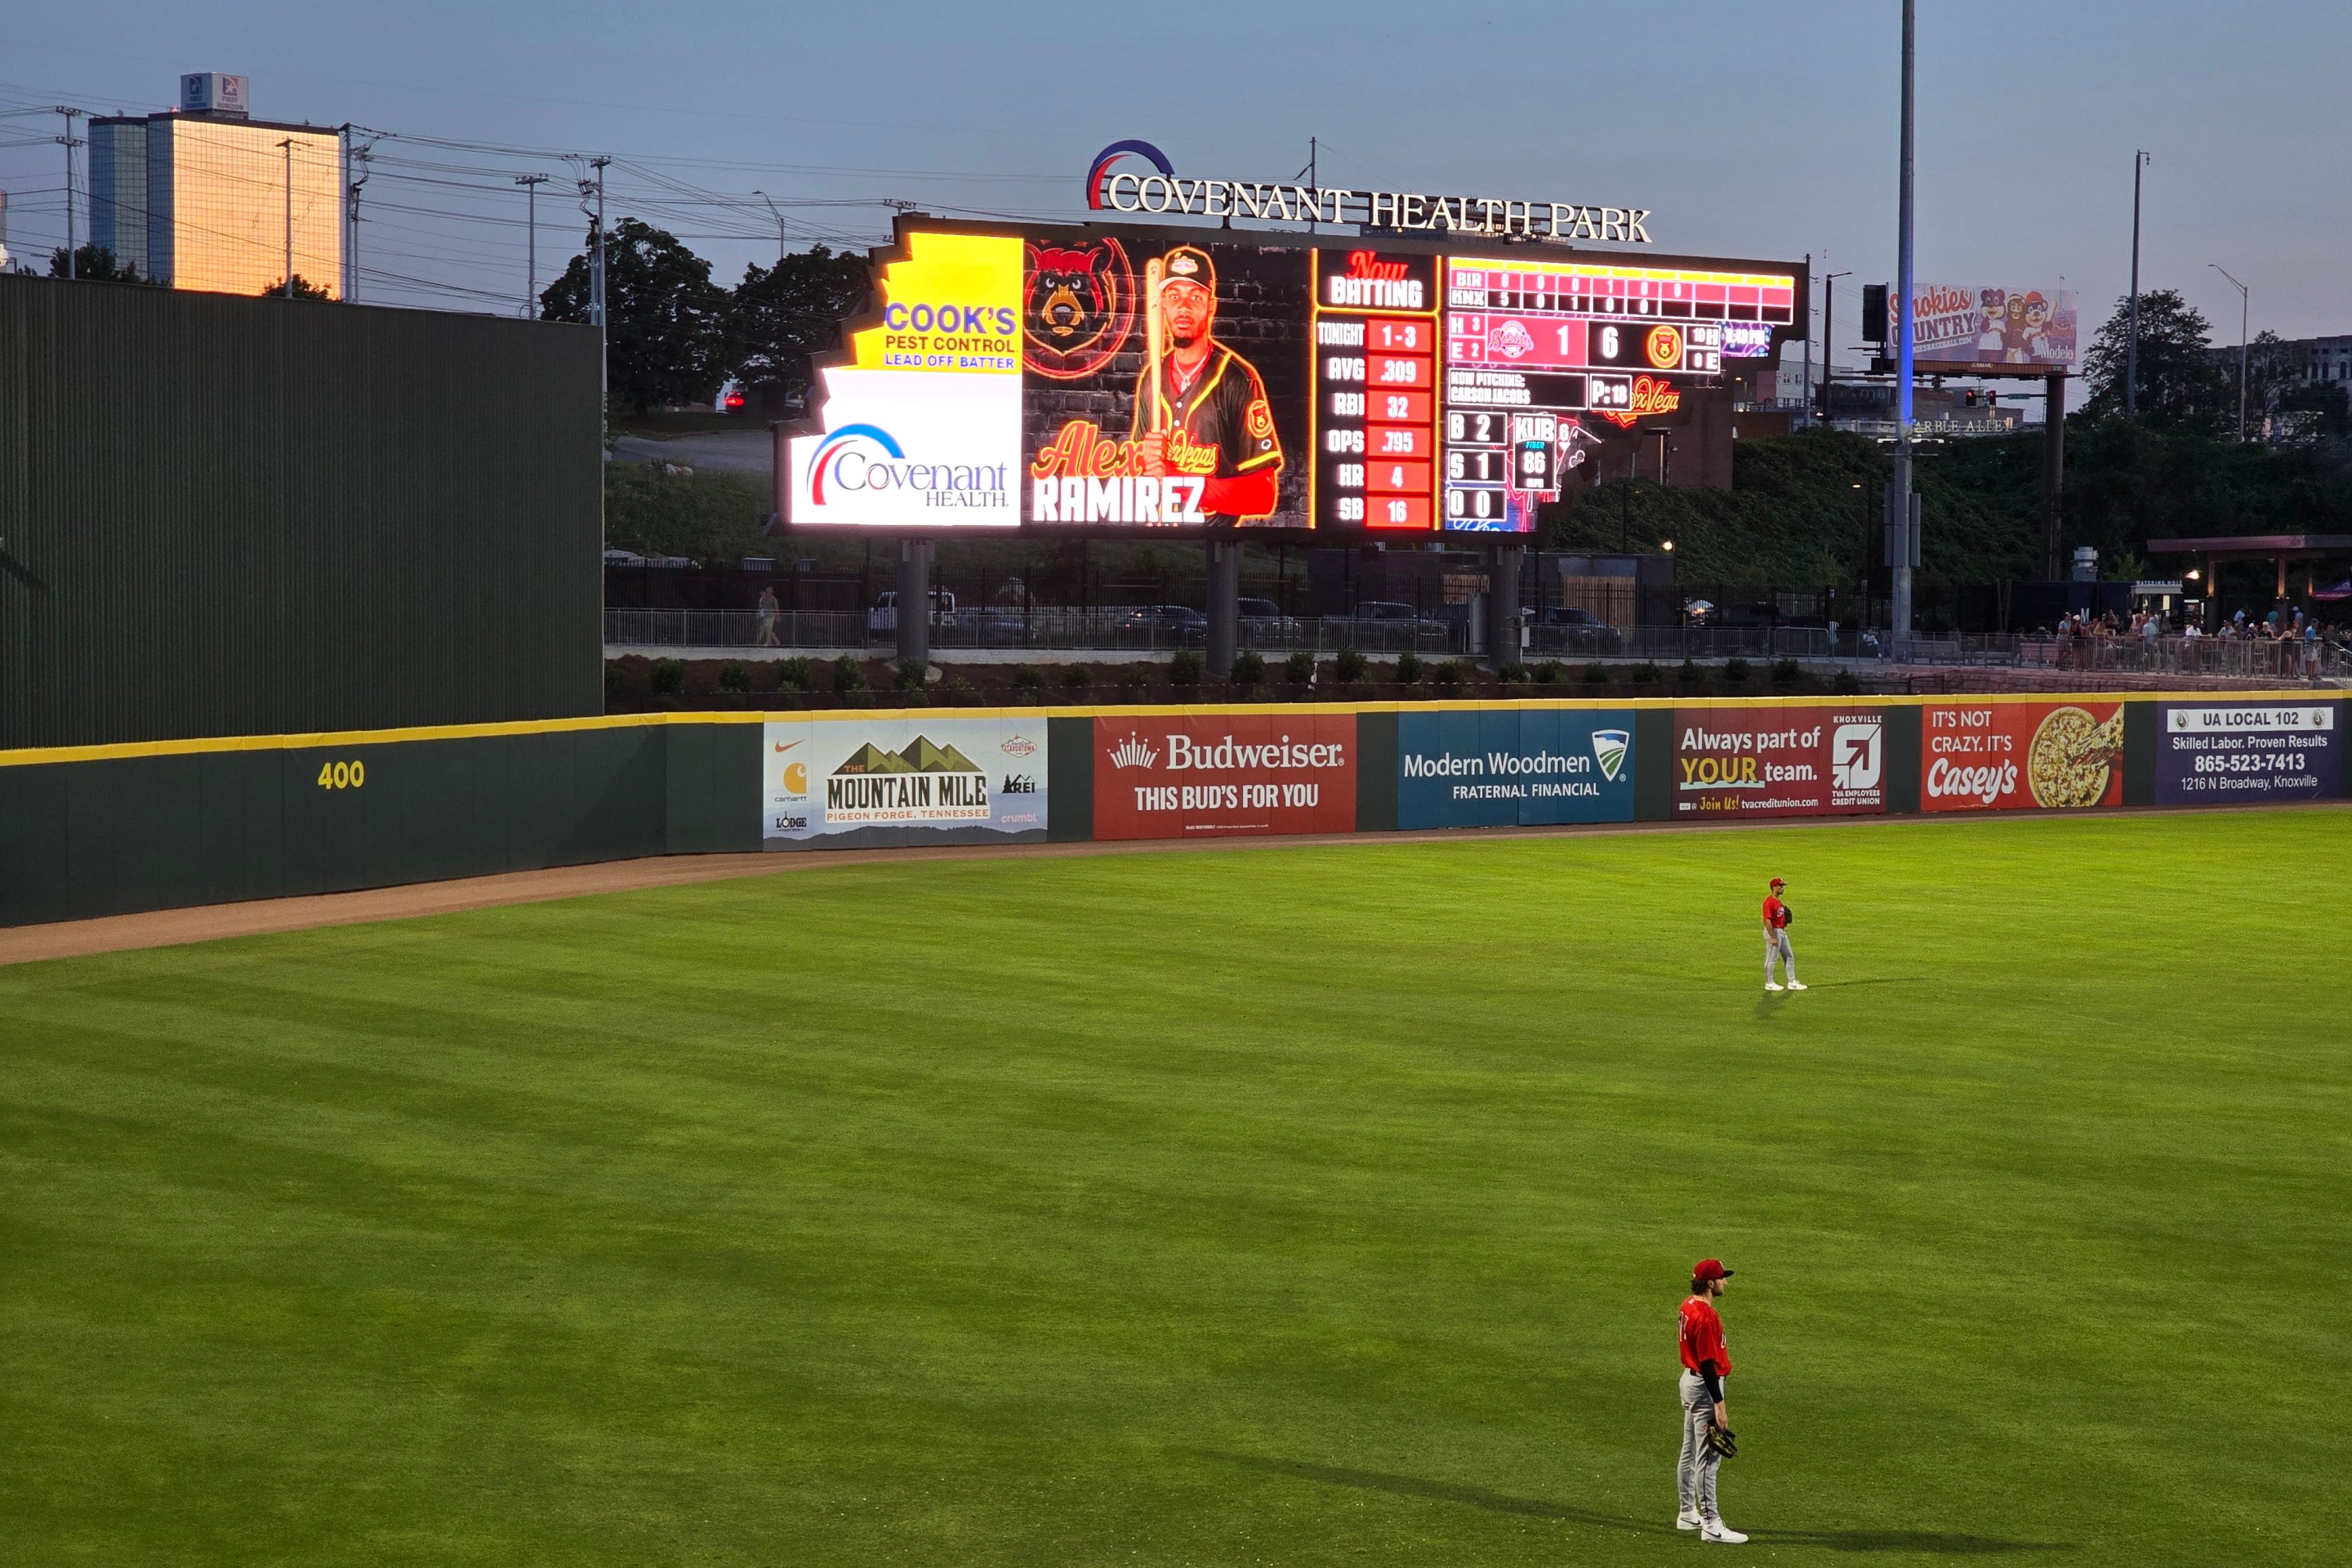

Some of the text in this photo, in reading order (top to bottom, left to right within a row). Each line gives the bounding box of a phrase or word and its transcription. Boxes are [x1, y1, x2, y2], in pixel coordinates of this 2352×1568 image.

[1108, 173, 1653, 243] COVENANT HEALTH PARK
[1346, 250, 1409, 280] Now
[1330, 275, 1423, 308] BATTING
[1456, 272, 1682, 297] BIR 0 0 0 1 0 0
[1451, 290, 1648, 314] KNX 5 0 1 0 0
[884, 302, 1016, 336] COOK'S
[1450, 317, 1480, 334] H 3
[885, 335, 929, 350] PEST
[1317, 322, 1365, 345] TONIGHT
[1557, 325, 1568, 355] 1
[1601, 326, 1619, 358] 6
[1693, 327, 1717, 345] 10 H
[1749, 330, 1765, 345] PM
[885, 354, 1014, 368] LEAD OFF BATTER
[1452, 342, 1479, 359] E 2
[1695, 353, 1717, 369] 0 E
[2041, 343, 2073, 359] Modelo
[1329, 357, 1365, 381] AVG
[1450, 372, 1525, 387] NOW PITCHING:
[1334, 392, 1409, 417] RBI 32
[1450, 386, 1491, 403] CARSON
[1450, 414, 1490, 441] B 2
[1515, 417, 1555, 440] KUB
[1913, 420, 2010, 433] ARBLE ALLEY
[1031, 420, 1144, 479] Alex
[1328, 430, 1413, 452] OPS .795
[1526, 441, 1545, 450] FIBER
[834, 452, 1007, 490] Covenant
[1450, 453, 1489, 479] S 1
[1524, 451, 1546, 474] 86
[1339, 463, 1403, 488] HR 4
[926, 491, 1006, 507] HEALTH
[1033, 474, 1205, 523] RAMIREZ
[1339, 497, 1406, 523] SB 16
[1477, 491, 1490, 518] 0
[1932, 710, 1992, 727] IT'S NOT
[2203, 711, 2299, 726] UA LOCAL 102
[1681, 726, 1820, 754] Always part of
[1931, 735, 2011, 752] CRAZY. IT'S
[2172, 735, 2328, 750] Skilled Labor. Proven Results
[1166, 735, 1342, 769] Budweiser
[2194, 753, 2305, 772] 865-523-7413
[318, 760, 364, 789] 400
[1405, 751, 1589, 777] Modern Woodmen
[1681, 757, 1817, 784] YOUR team.
[1013, 782, 1036, 793] REI
[1453, 782, 1599, 799] FRATERNAL FINANCIAL
[1927, 757, 2018, 804] Casey's
[2181, 775, 2318, 791] 1216 N Broadway, Knoxville
[826, 776, 987, 809] MOUNTAIN MILE
[1134, 783, 1318, 810] THIS BUD'S FOR YOU
[1699, 795, 1818, 810] Join Us! tvacreditunion.com
[1857, 797, 1880, 805] UNION
[776, 817, 807, 828] LODGE
[826, 809, 989, 821] PIGEON FORGE, TENNESSEE
[1001, 813, 1036, 823] crumbl
